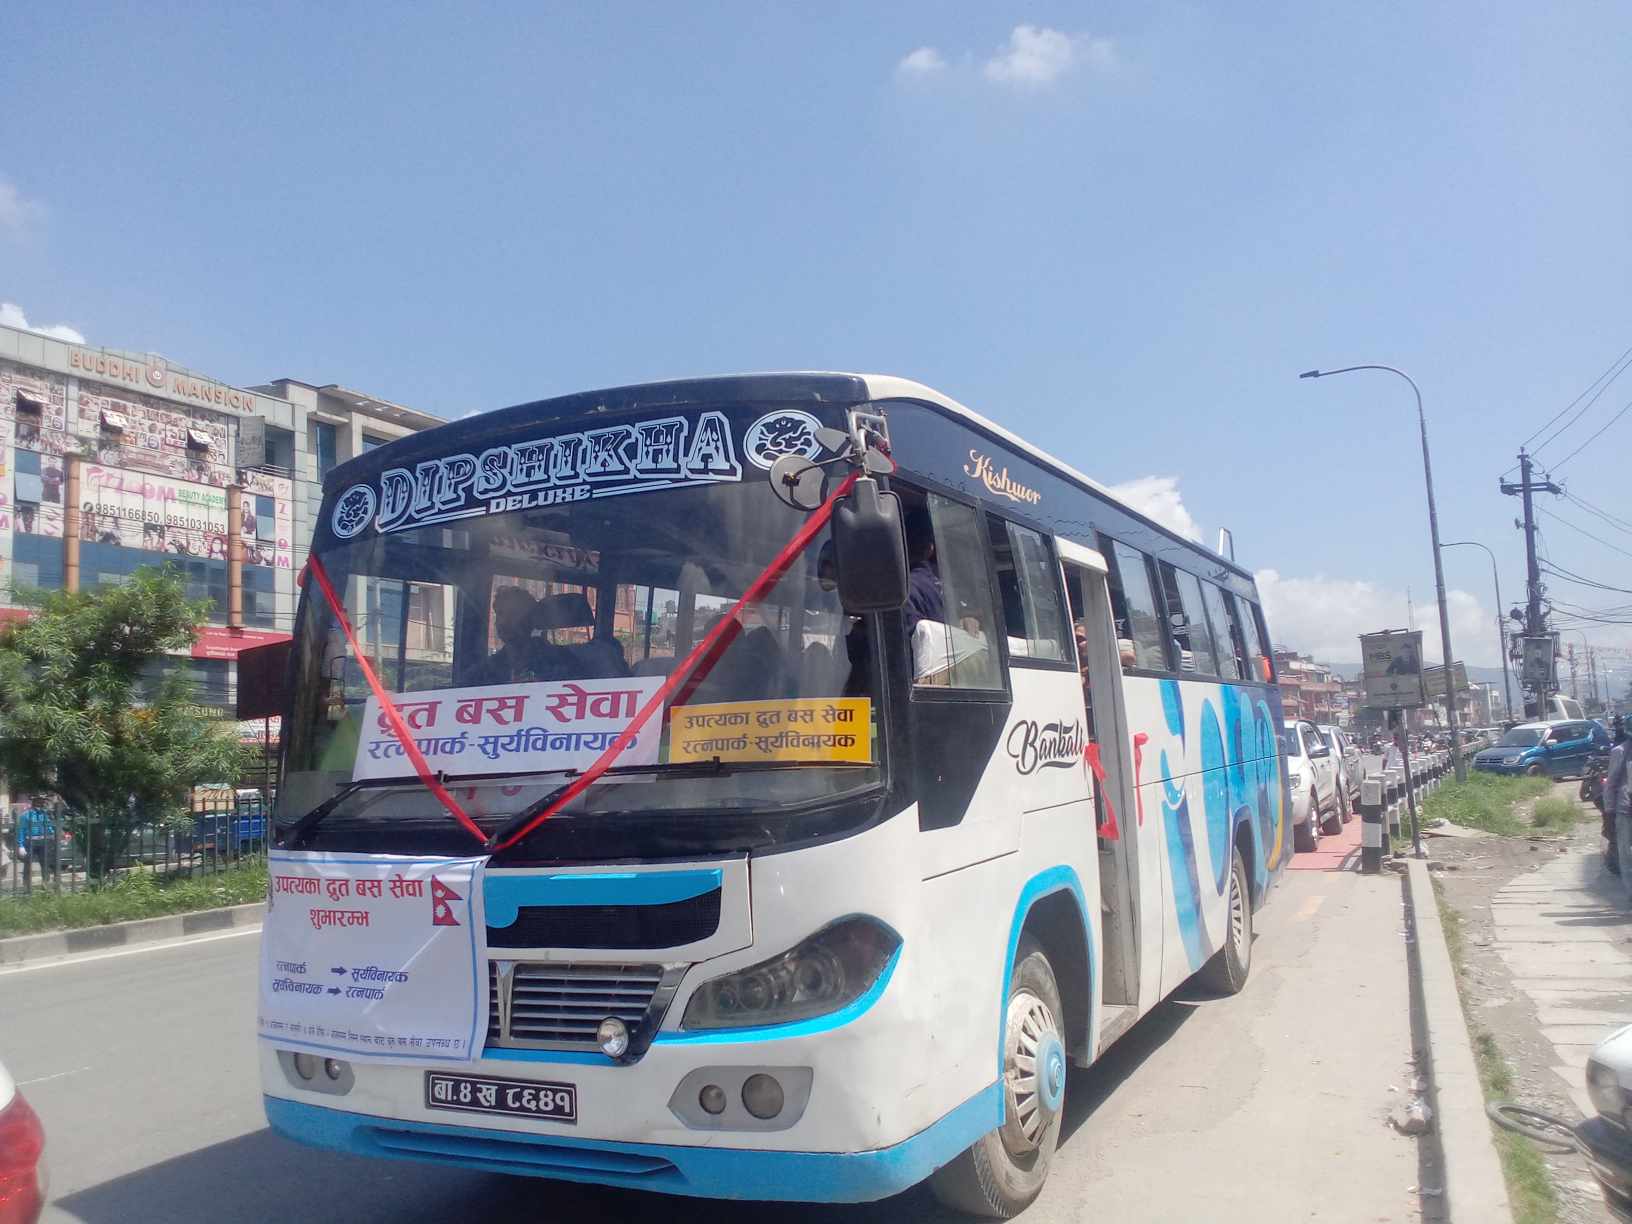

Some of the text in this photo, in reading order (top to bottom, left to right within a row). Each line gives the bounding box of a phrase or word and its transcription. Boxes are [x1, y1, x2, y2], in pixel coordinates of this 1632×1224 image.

[70, 351, 257, 413] BUDDHI MANSION
[375, 411, 742, 534] DIPSHIKHA
[488, 484, 591, 514] DELUXE
[456, 695, 530, 726] बस
[545, 684, 643, 723] सेवा
[684, 711, 750, 729] उपत्यका
[787, 708, 814, 724] बस
[821, 705, 855, 723] सेवा
[274, 873, 424, 902] उपत्यका द्रुत बस सेवा
[506, 1087, 571, 1113] ८६४१
